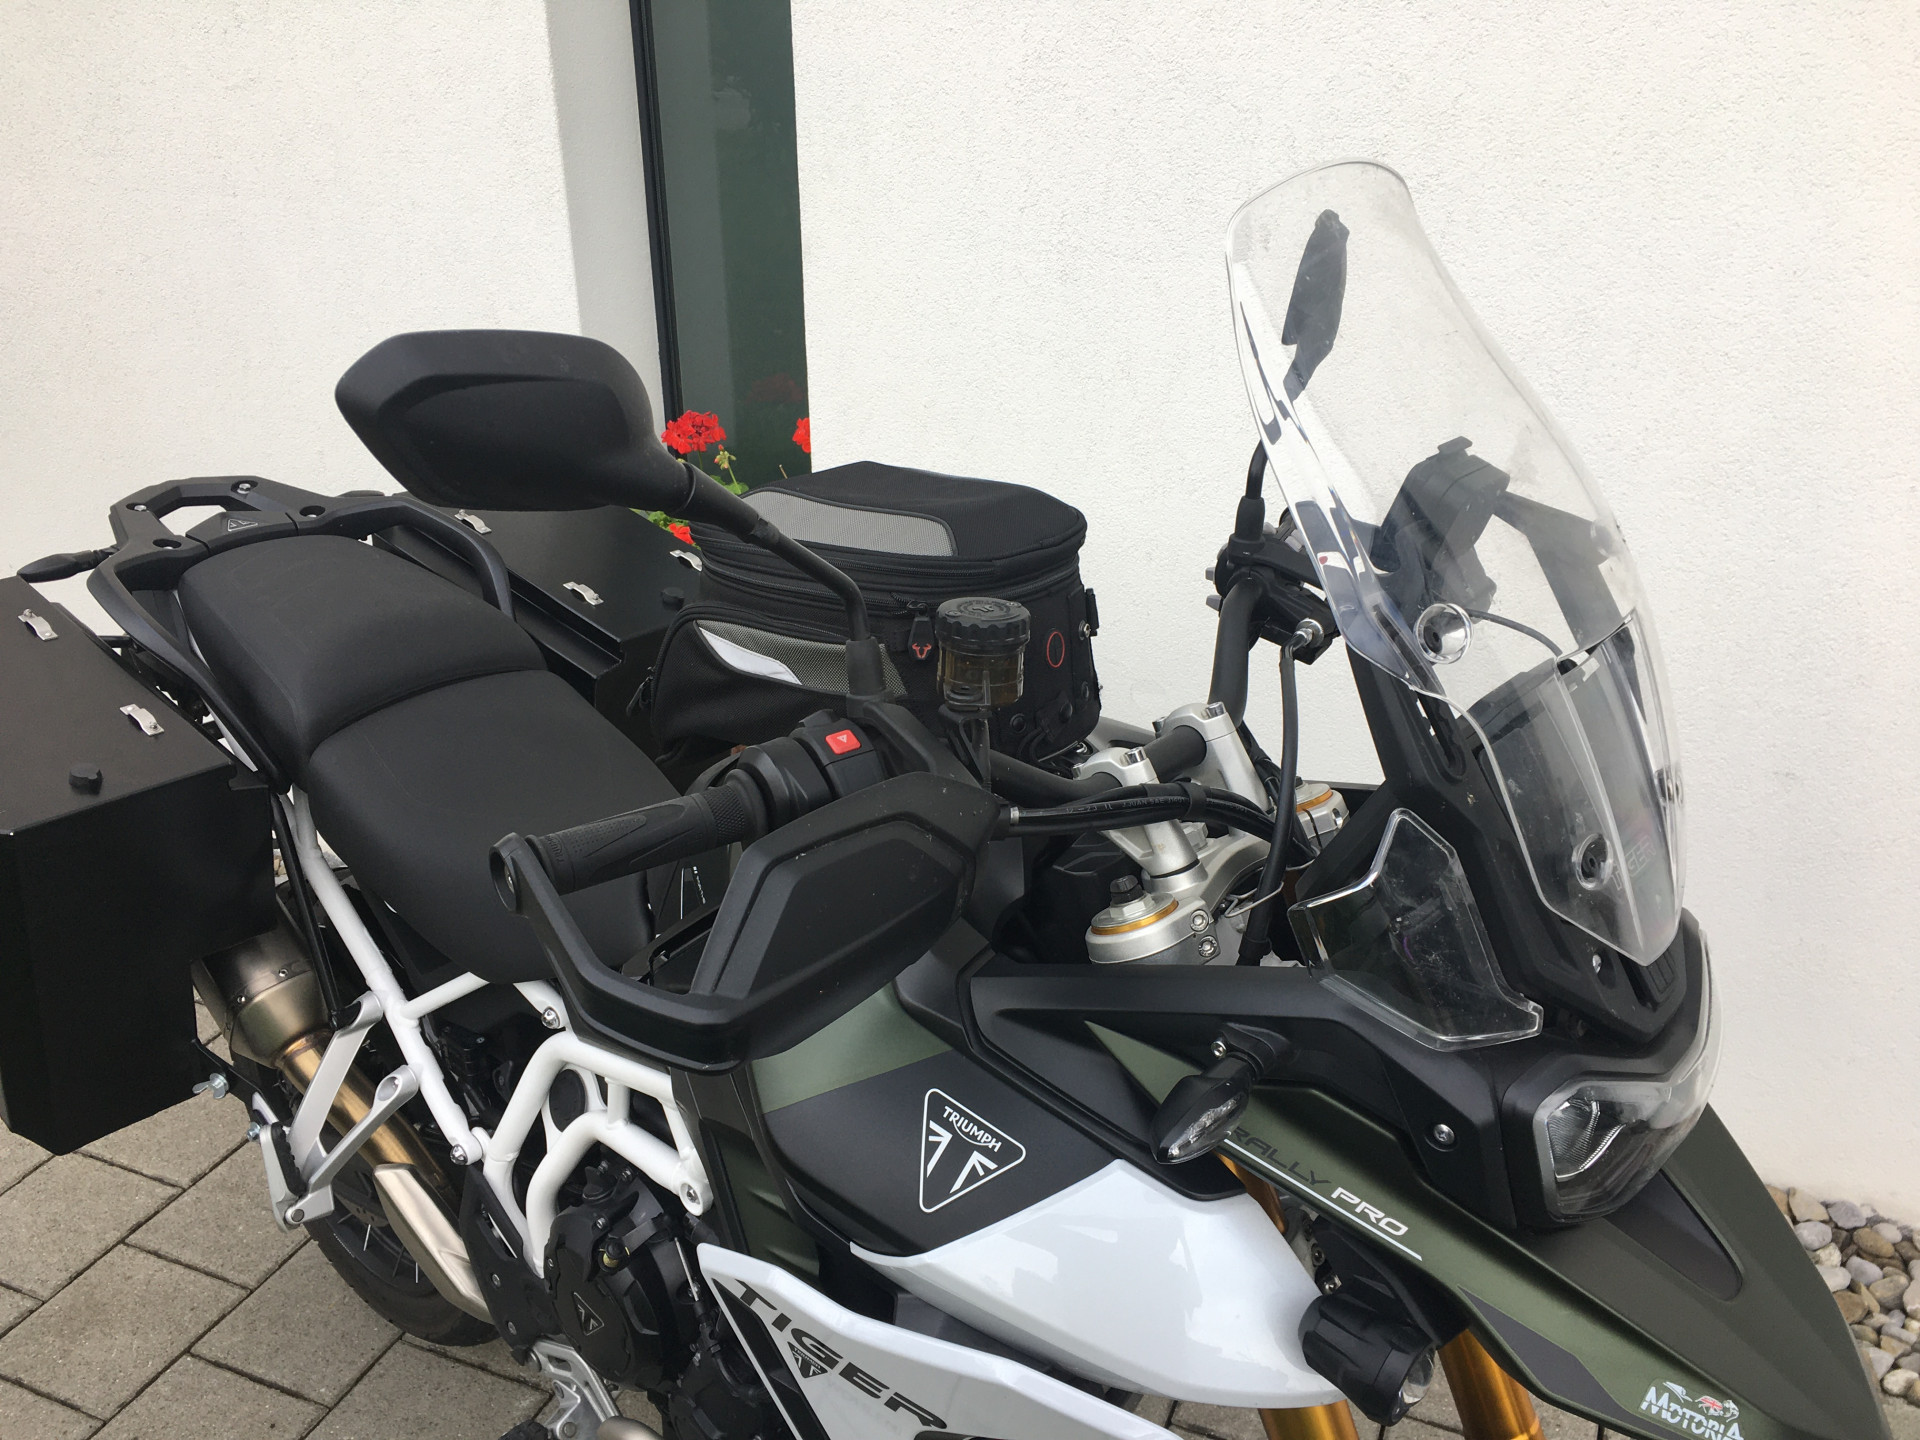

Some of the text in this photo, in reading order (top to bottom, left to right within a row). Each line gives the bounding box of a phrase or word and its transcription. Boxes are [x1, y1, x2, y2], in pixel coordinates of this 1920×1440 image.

[1605, 834, 1657, 891] TGER
[943, 1105, 1002, 1153] TRIUMPH
[1233, 1126, 1409, 1236] RALLY PRO
[734, 1278, 948, 1430] TIGER
